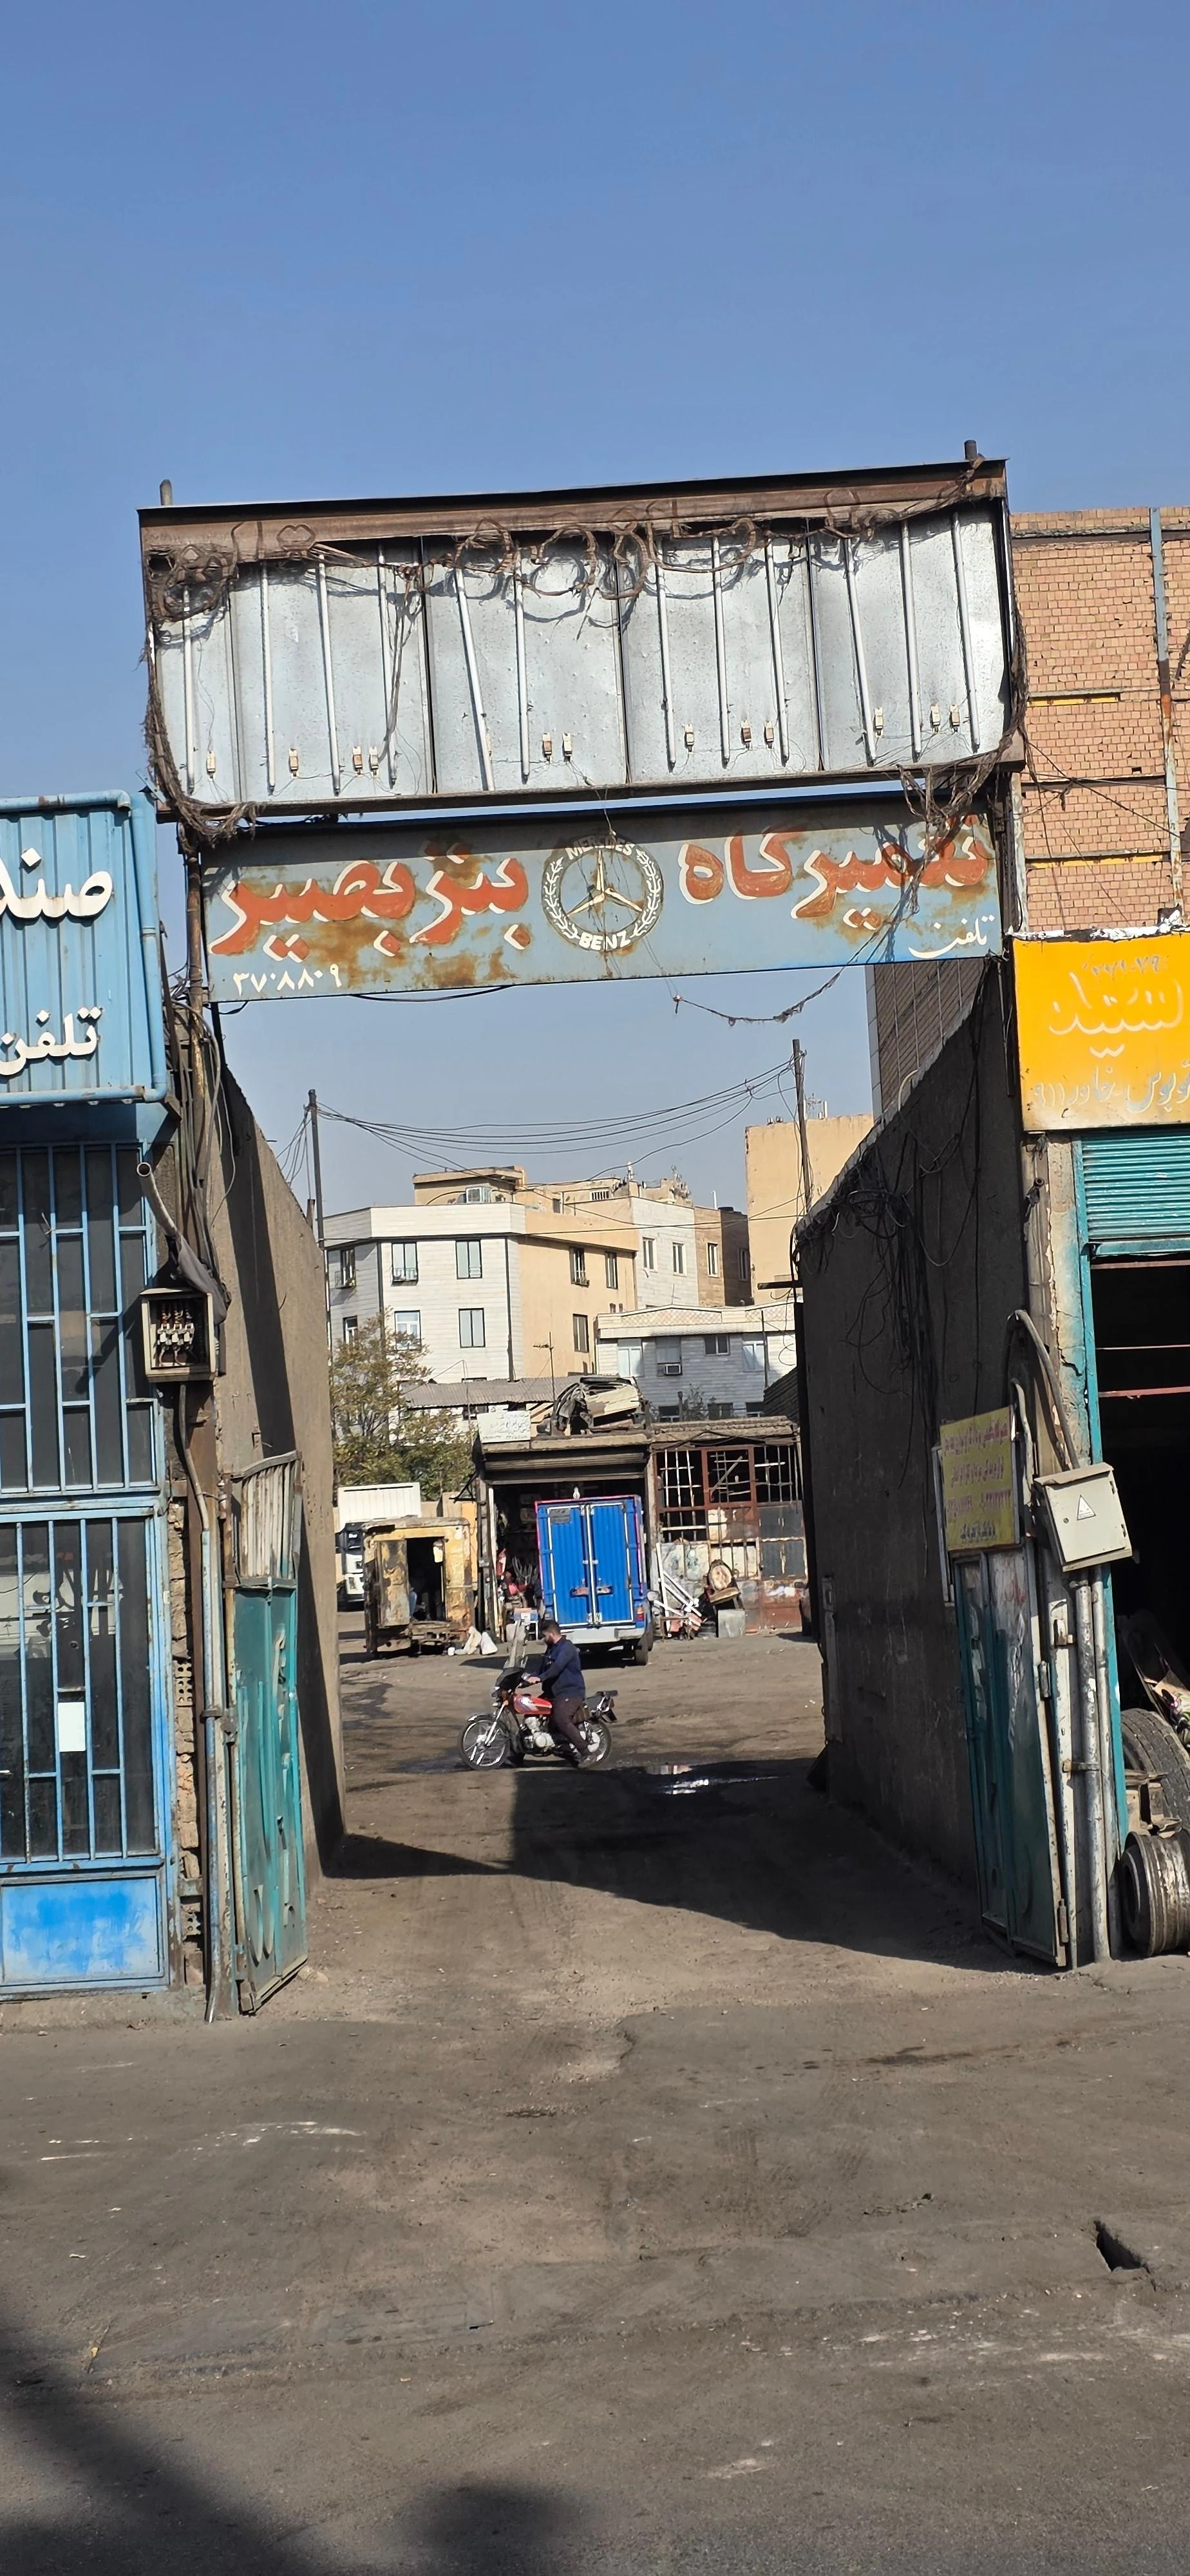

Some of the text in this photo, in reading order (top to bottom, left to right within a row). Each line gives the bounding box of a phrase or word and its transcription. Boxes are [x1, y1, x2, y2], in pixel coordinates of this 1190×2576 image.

[207, 860, 416, 963] بصیر
[409, 840, 530, 950] بنز
[578, 930, 632, 951] BENZ
[908, 914, 995, 959] تلفن
[232, 963, 343, 997] ۳۷۰۸۸۰۹
